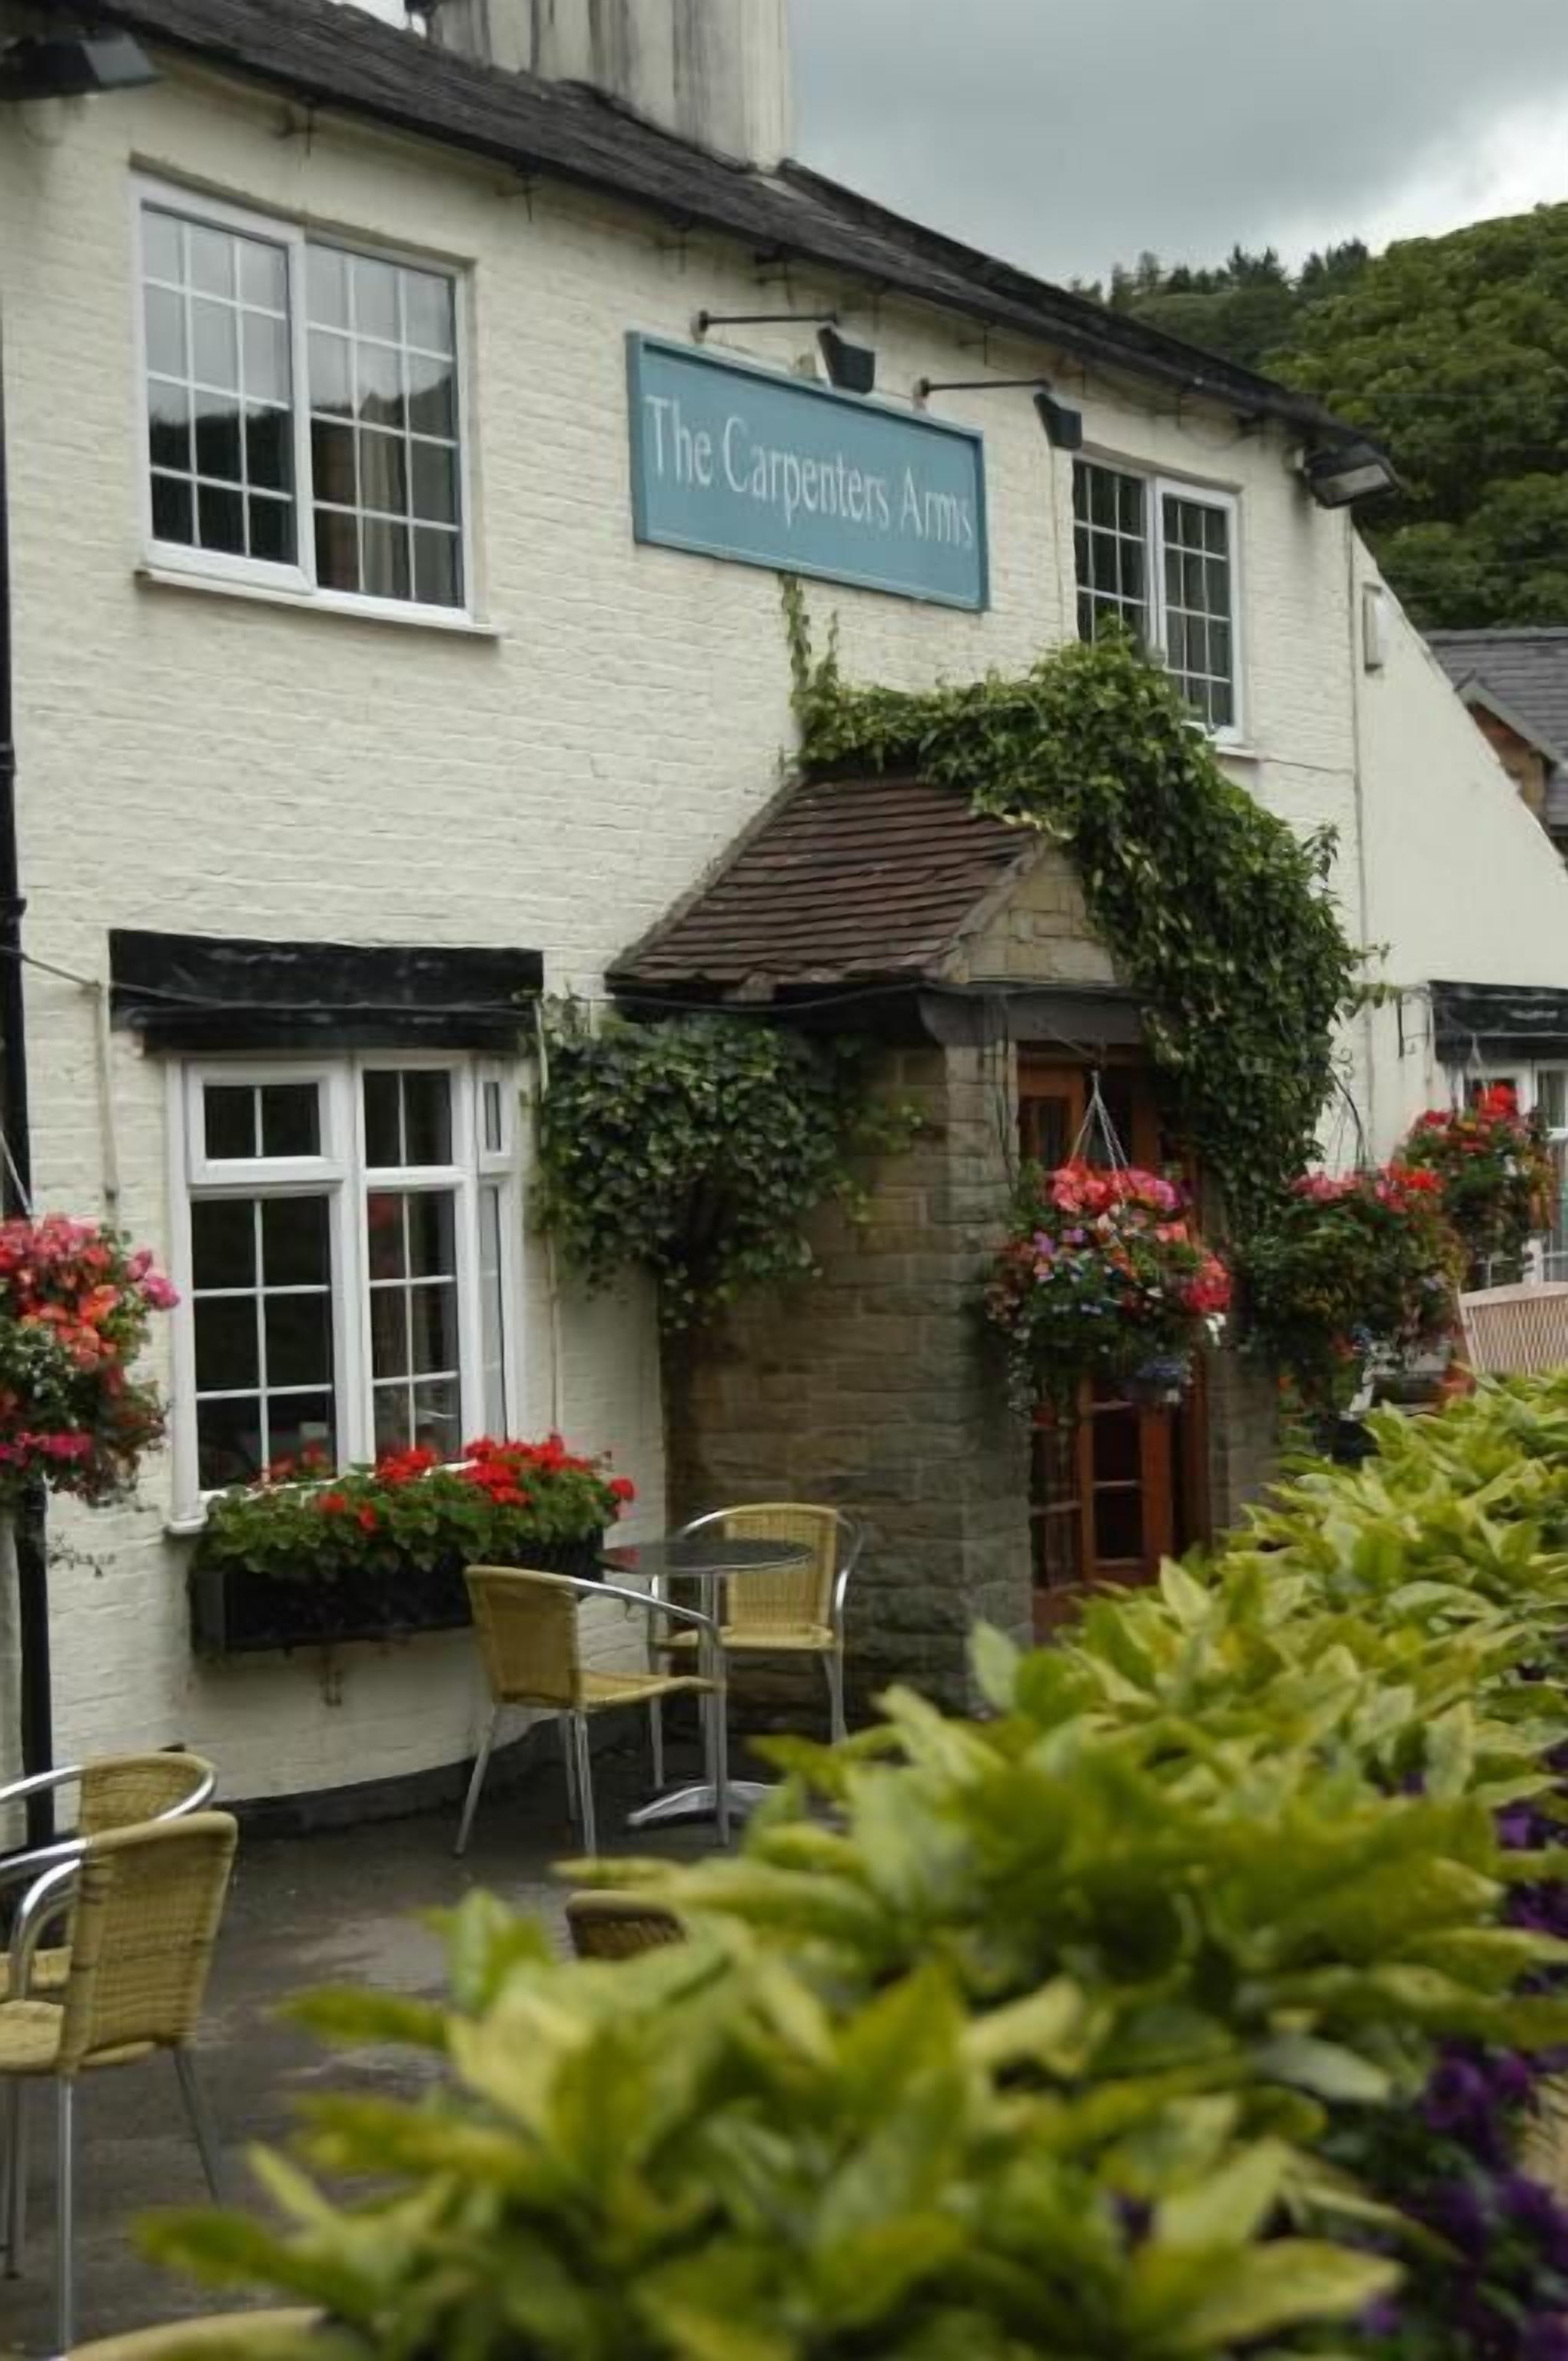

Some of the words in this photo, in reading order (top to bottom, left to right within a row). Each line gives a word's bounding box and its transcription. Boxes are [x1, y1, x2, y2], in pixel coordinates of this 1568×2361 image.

[643, 394, 713, 486] The
[723, 414, 890, 529] Carpenters
[900, 467, 973, 549] Arms
